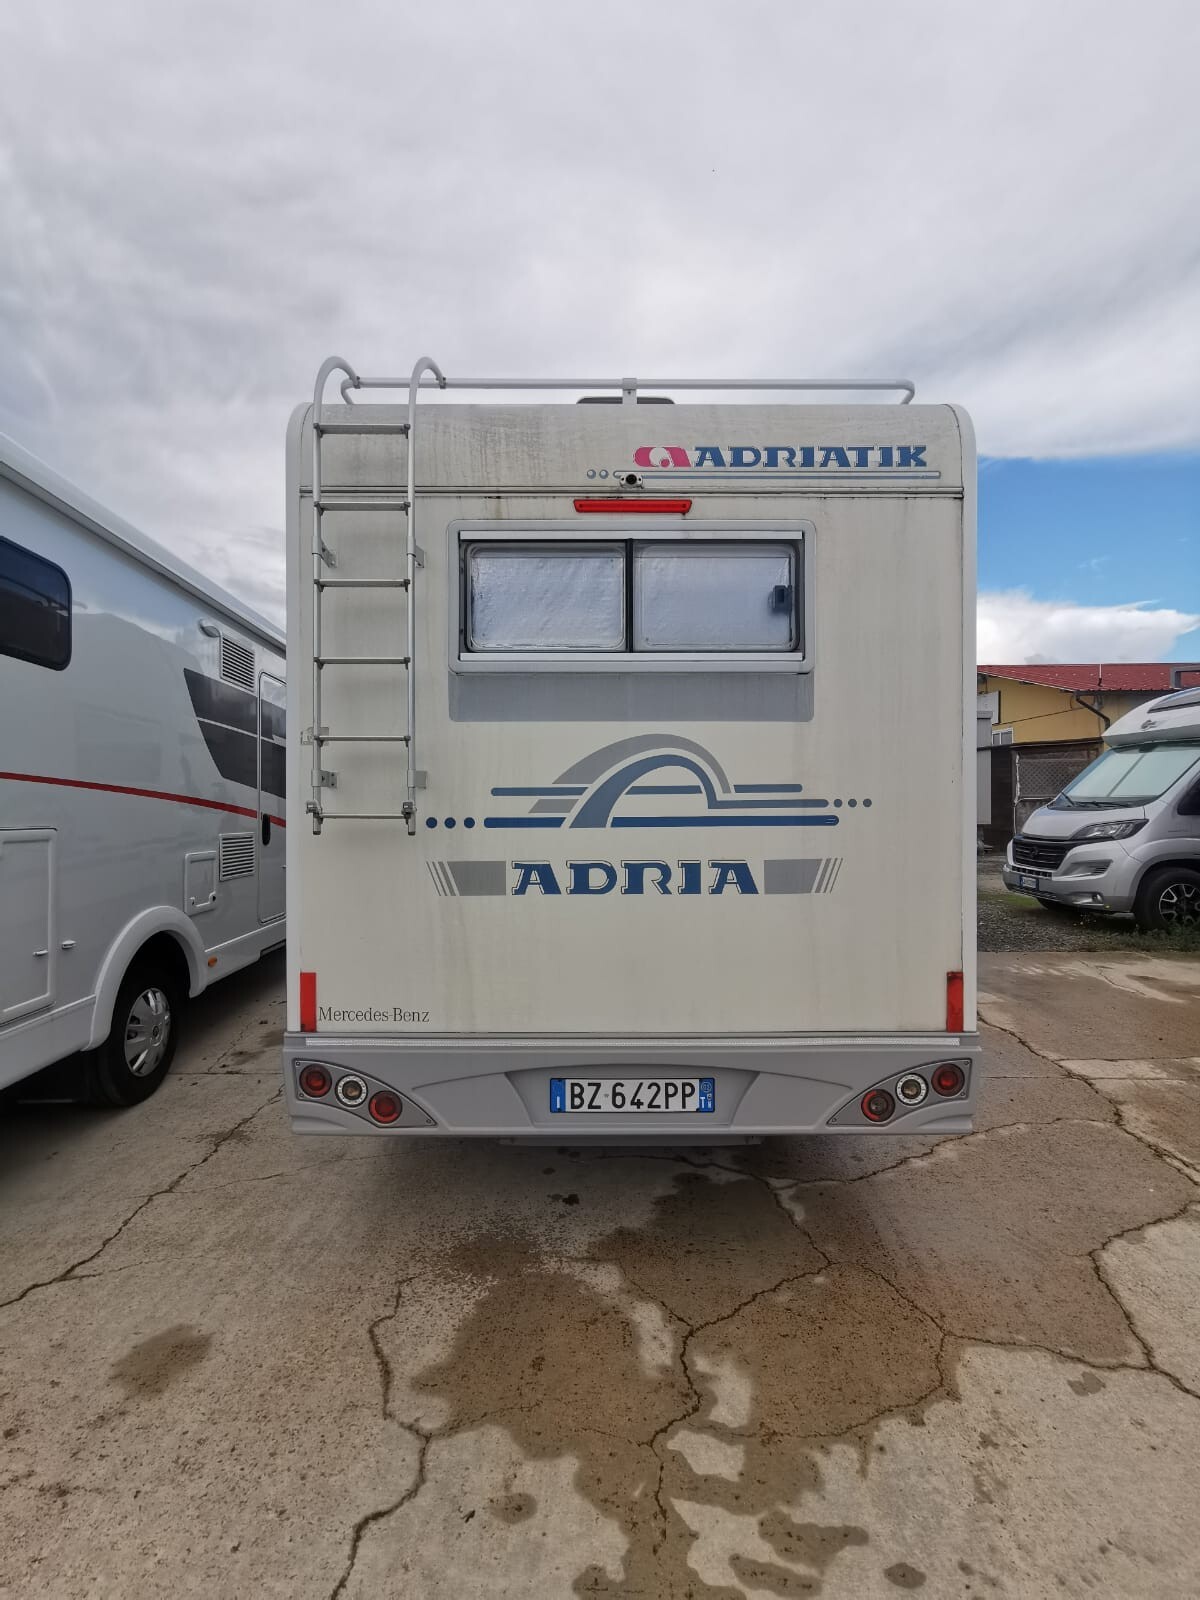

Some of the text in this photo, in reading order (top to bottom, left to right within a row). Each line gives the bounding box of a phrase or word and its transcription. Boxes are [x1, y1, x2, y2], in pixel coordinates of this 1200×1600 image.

[694, 445, 928, 468] ADRIATIK
[511, 859, 759, 895] ADRIA
[319, 1006, 431, 1022] Mercedes-Benz
